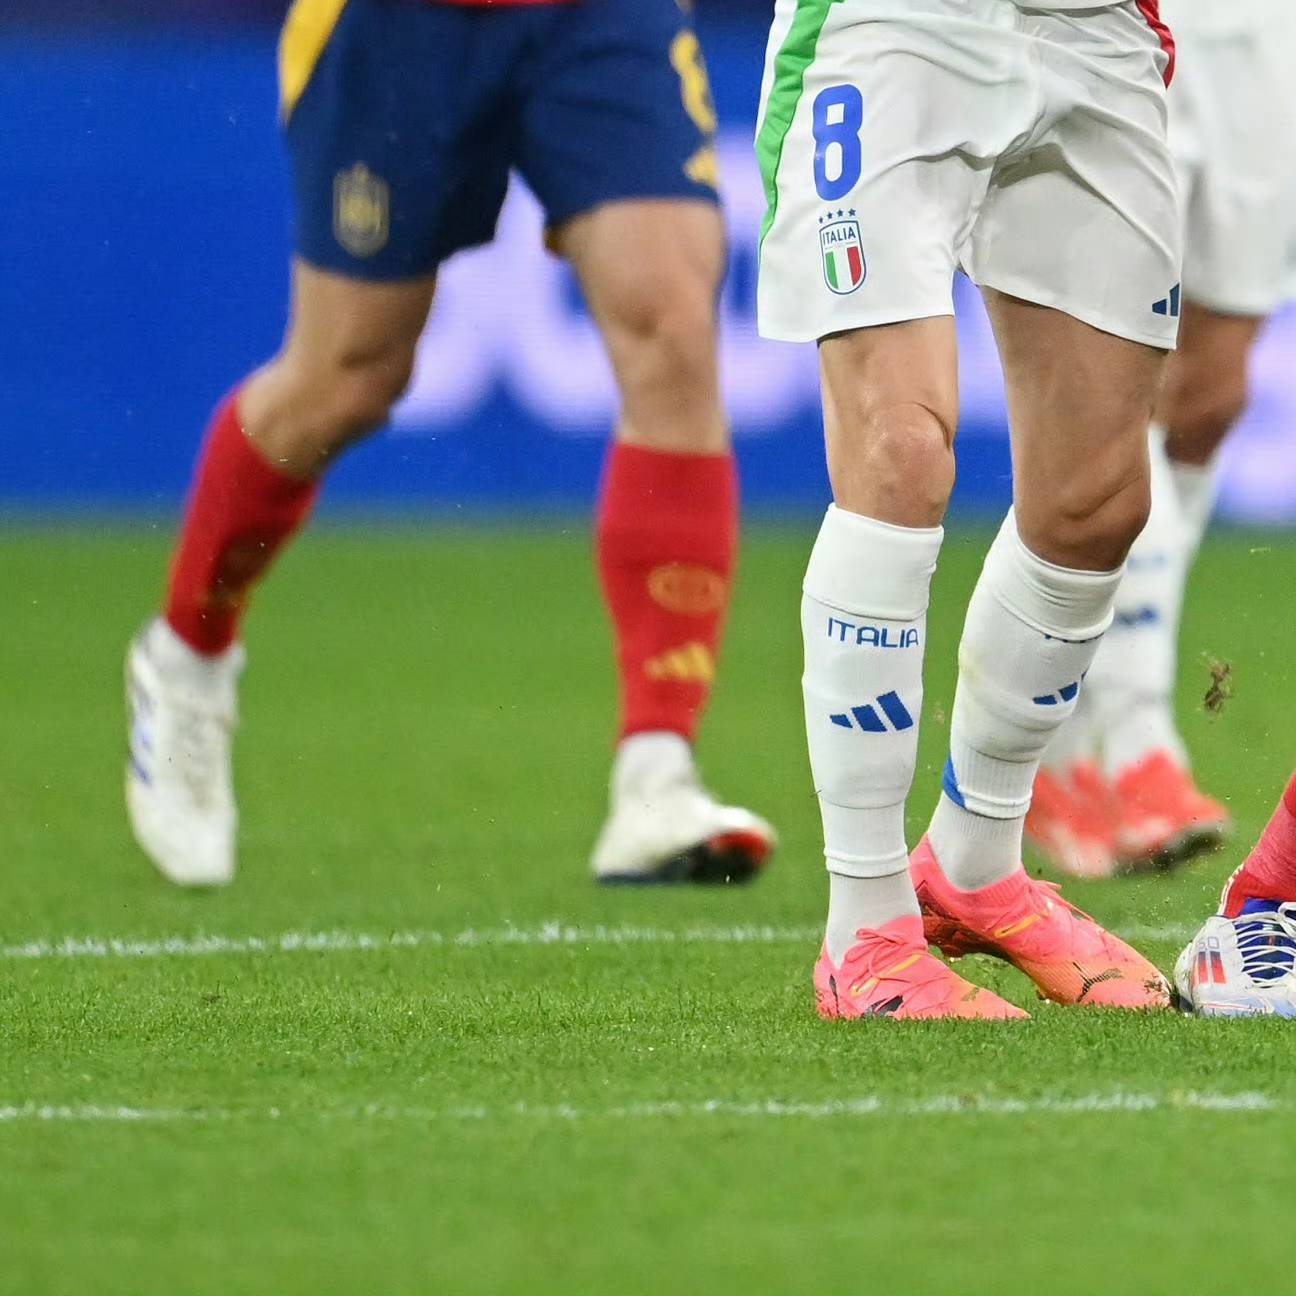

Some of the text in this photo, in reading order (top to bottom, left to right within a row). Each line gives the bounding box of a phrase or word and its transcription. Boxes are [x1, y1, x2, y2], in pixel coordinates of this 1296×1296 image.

[812, 83, 863, 201] 8
[822, 226, 857, 247] ITALIA
[827, 617, 920, 649] ITALIA
